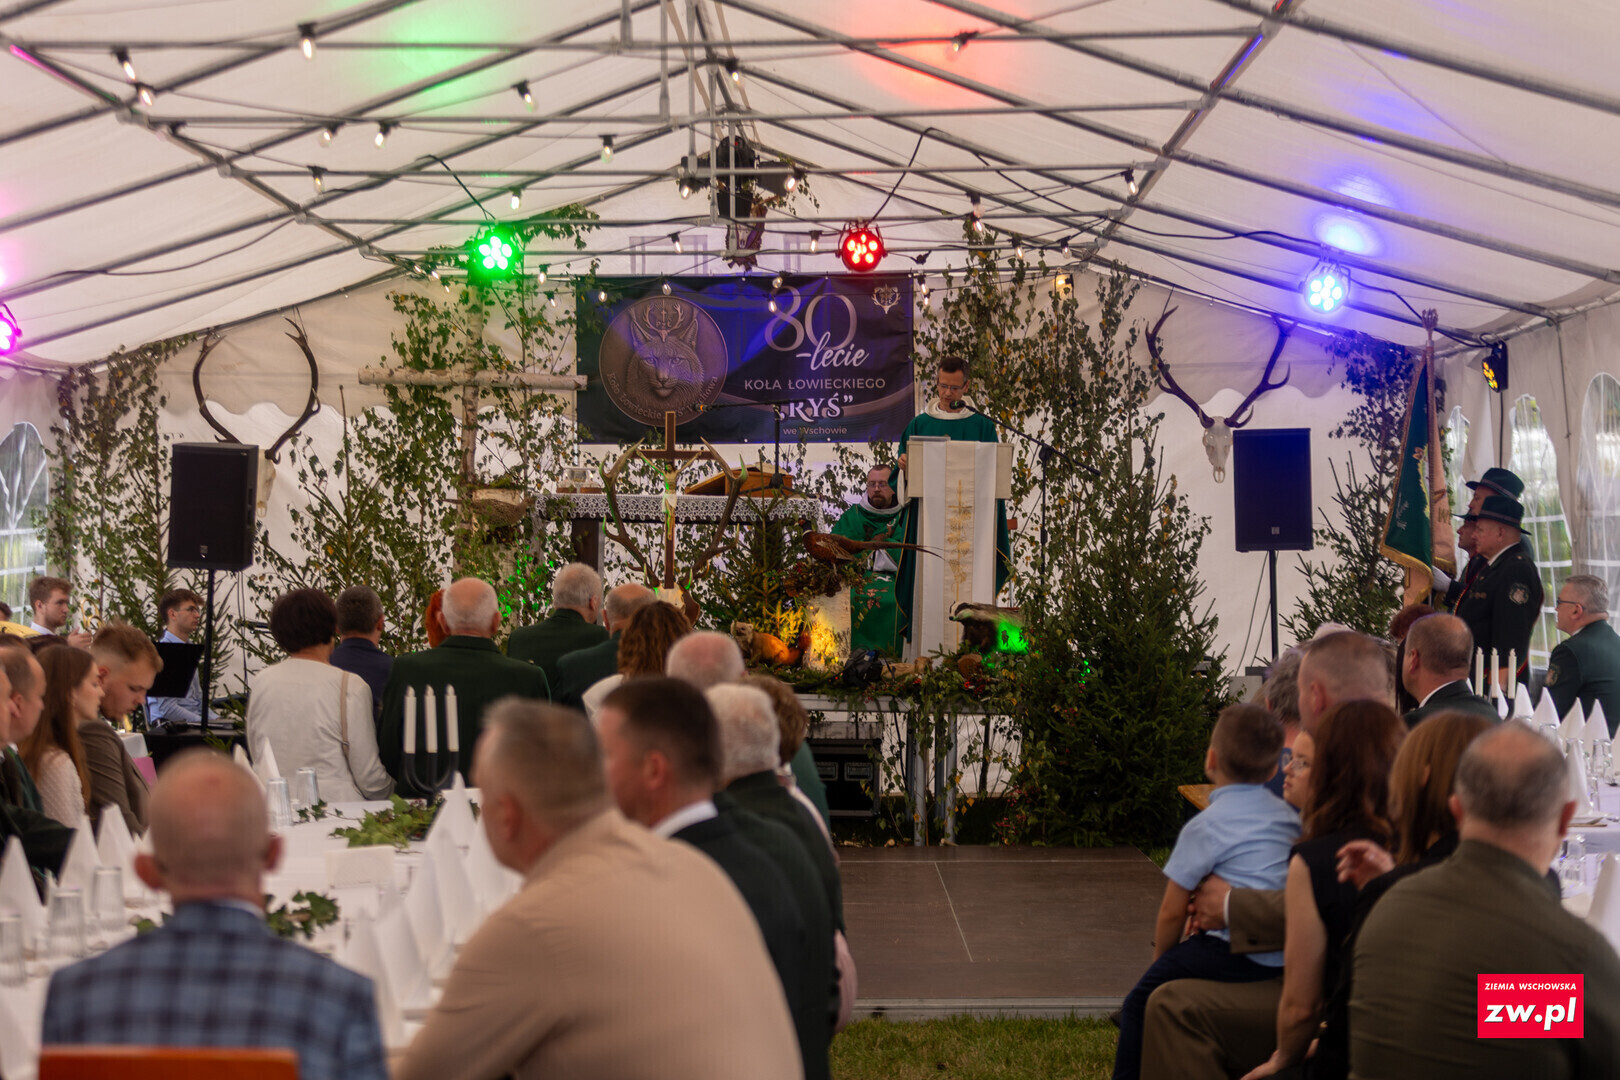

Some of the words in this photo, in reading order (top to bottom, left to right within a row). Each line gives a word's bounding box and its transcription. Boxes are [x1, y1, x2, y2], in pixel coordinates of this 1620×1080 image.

[765, 286, 857, 351] 80
[796, 331, 869, 370] -lecie
[744, 379, 782, 390] KOŁA
[788, 378, 886, 390] ŁOWIECKIEGO
[783, 427, 797, 435] we
[800, 426, 848, 435] Wschowie
